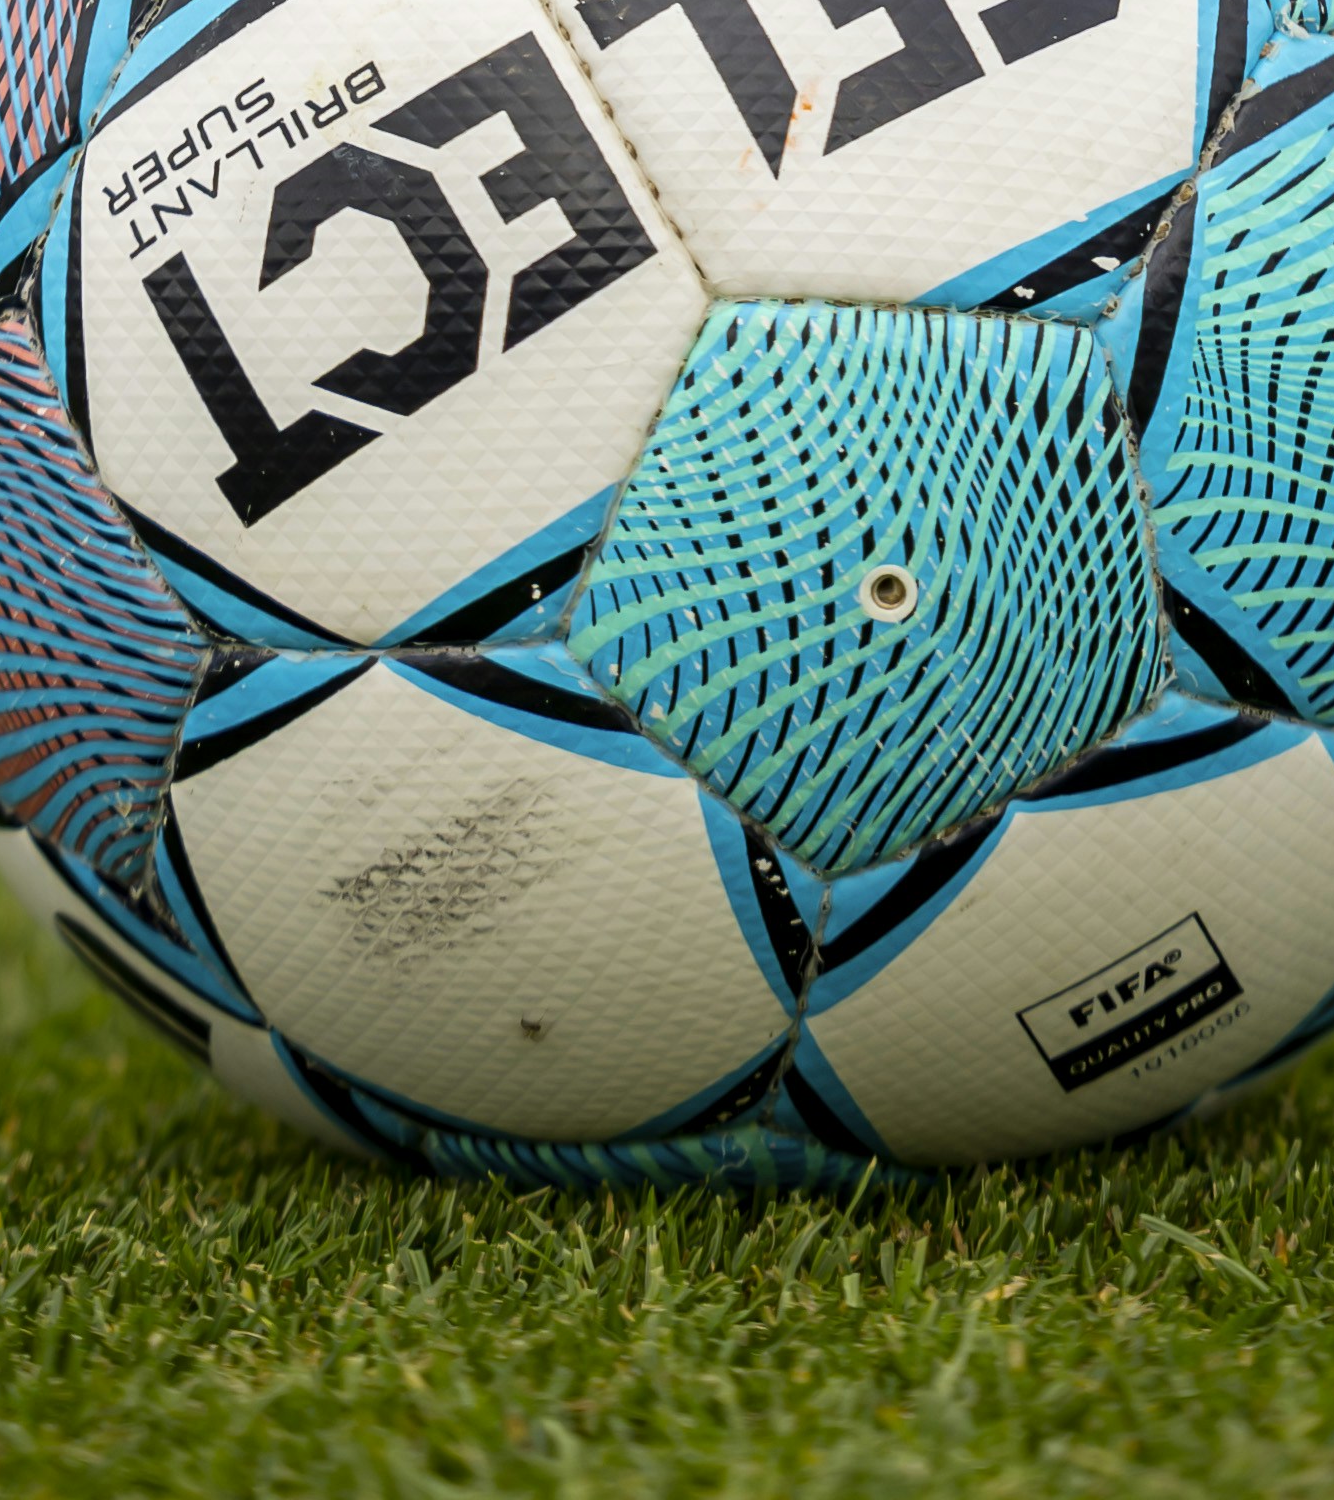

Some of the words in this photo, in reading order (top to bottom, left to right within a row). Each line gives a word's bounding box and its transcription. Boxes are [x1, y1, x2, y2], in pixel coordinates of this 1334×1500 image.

[102, 78, 275, 216] SUPER
[129, 61, 386, 259] BRILLANT
[1070, 1014, 1167, 1076] QUALITY
[1175, 981, 1223, 1020] PRO
